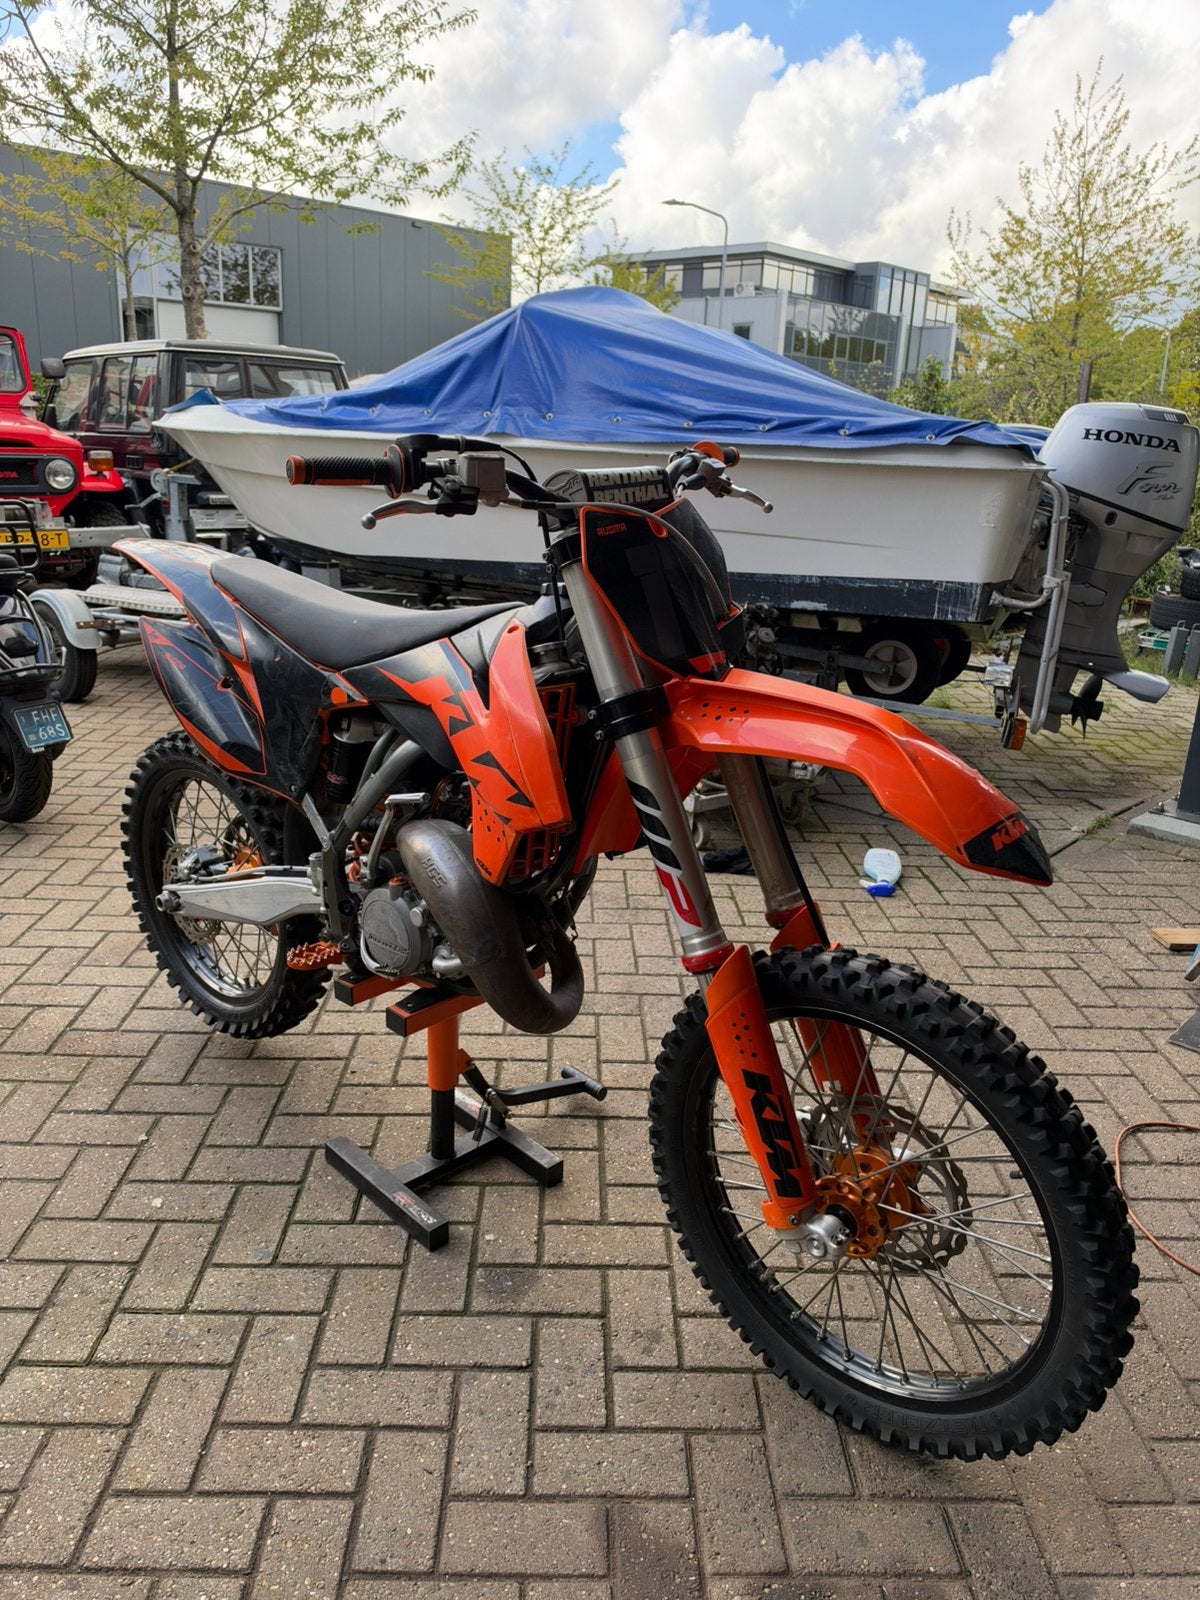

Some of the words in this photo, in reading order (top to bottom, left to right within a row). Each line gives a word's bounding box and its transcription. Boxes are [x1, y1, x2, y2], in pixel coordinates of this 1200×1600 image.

[1081, 427, 1182, 454] HONDA
[588, 468, 664, 488] RENTHAL
[593, 484, 669, 503] RENTHAL
[31, 707, 58, 725] FHF
[38, 723, 66, 740] 68S
[991, 816, 1030, 852] KTM
[741, 1068, 804, 1198] KTM
